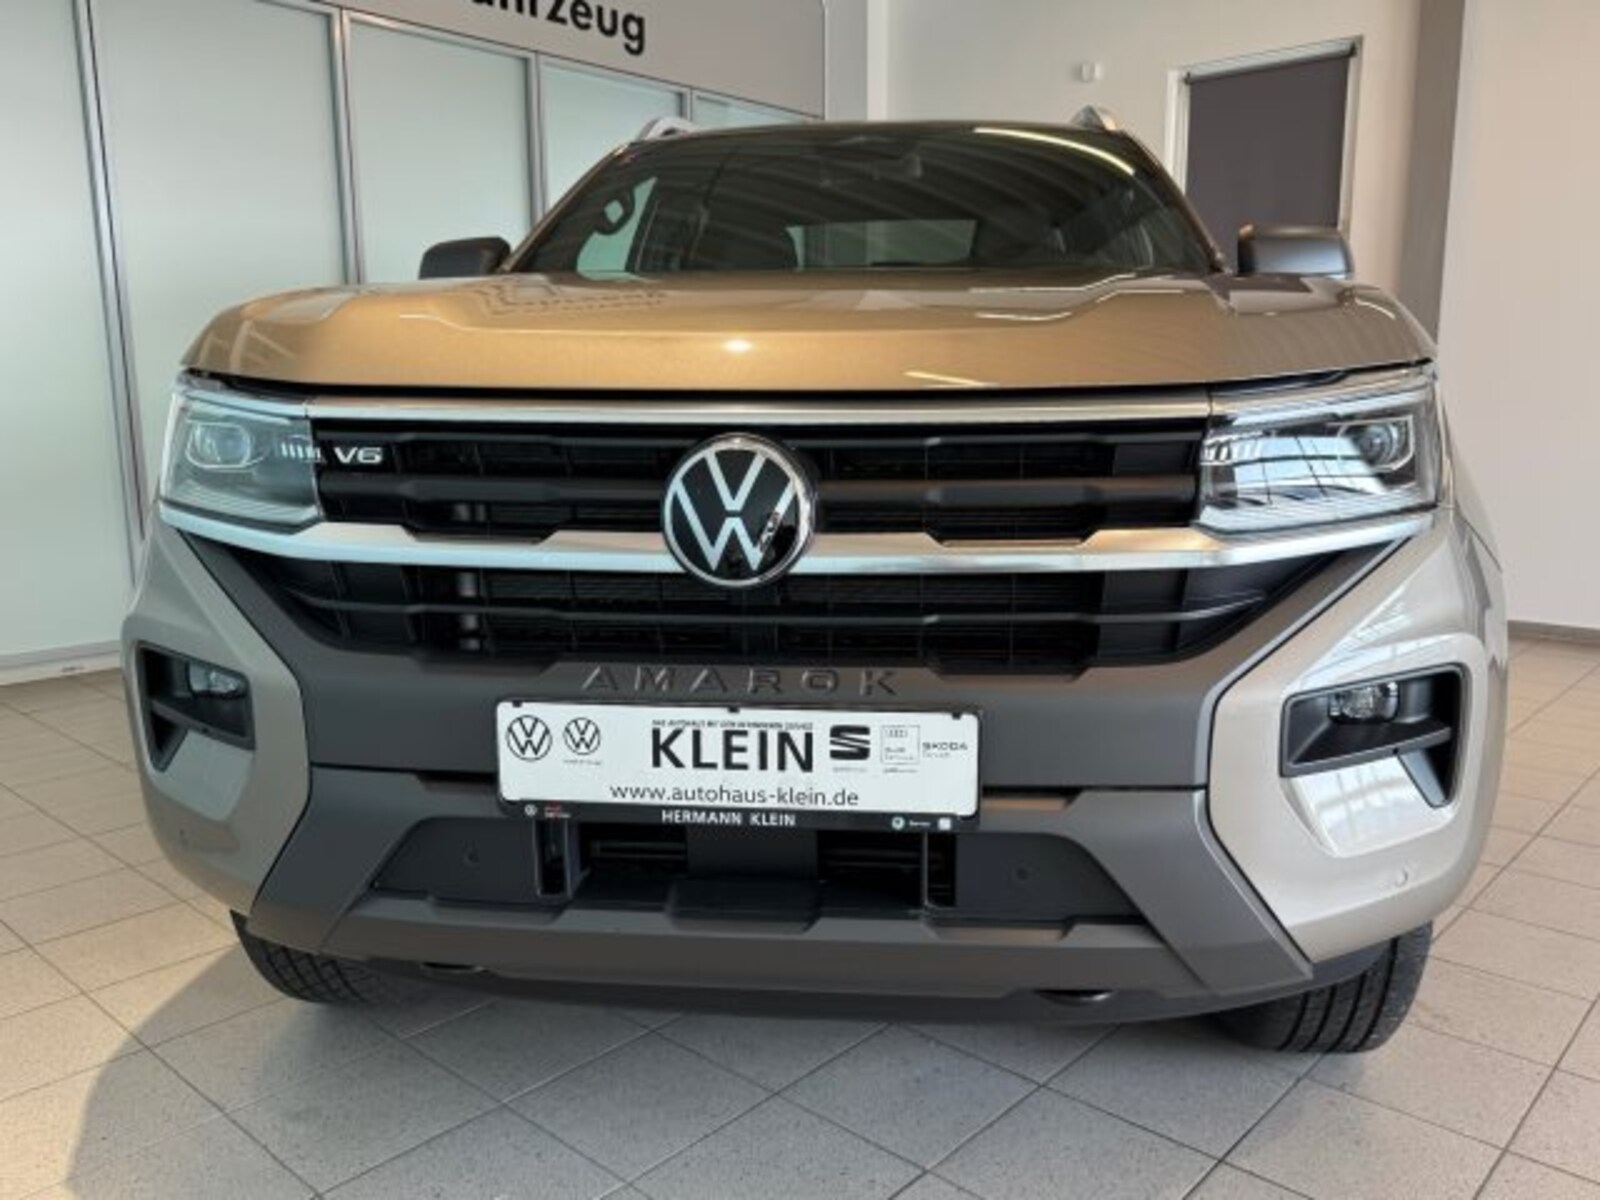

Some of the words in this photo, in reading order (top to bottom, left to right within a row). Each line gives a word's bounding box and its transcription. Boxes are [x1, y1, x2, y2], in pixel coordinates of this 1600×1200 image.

[471, 0, 646, 56] zeug
[334, 446, 383, 463] V6
[582, 665, 897, 696] AMAROK
[652, 727, 813, 773] KLEIN
[609, 784, 860, 807] www.autohaus-klein.de
[661, 809, 743, 826] HERMANN
[750, 811, 796, 827] KLEIN
